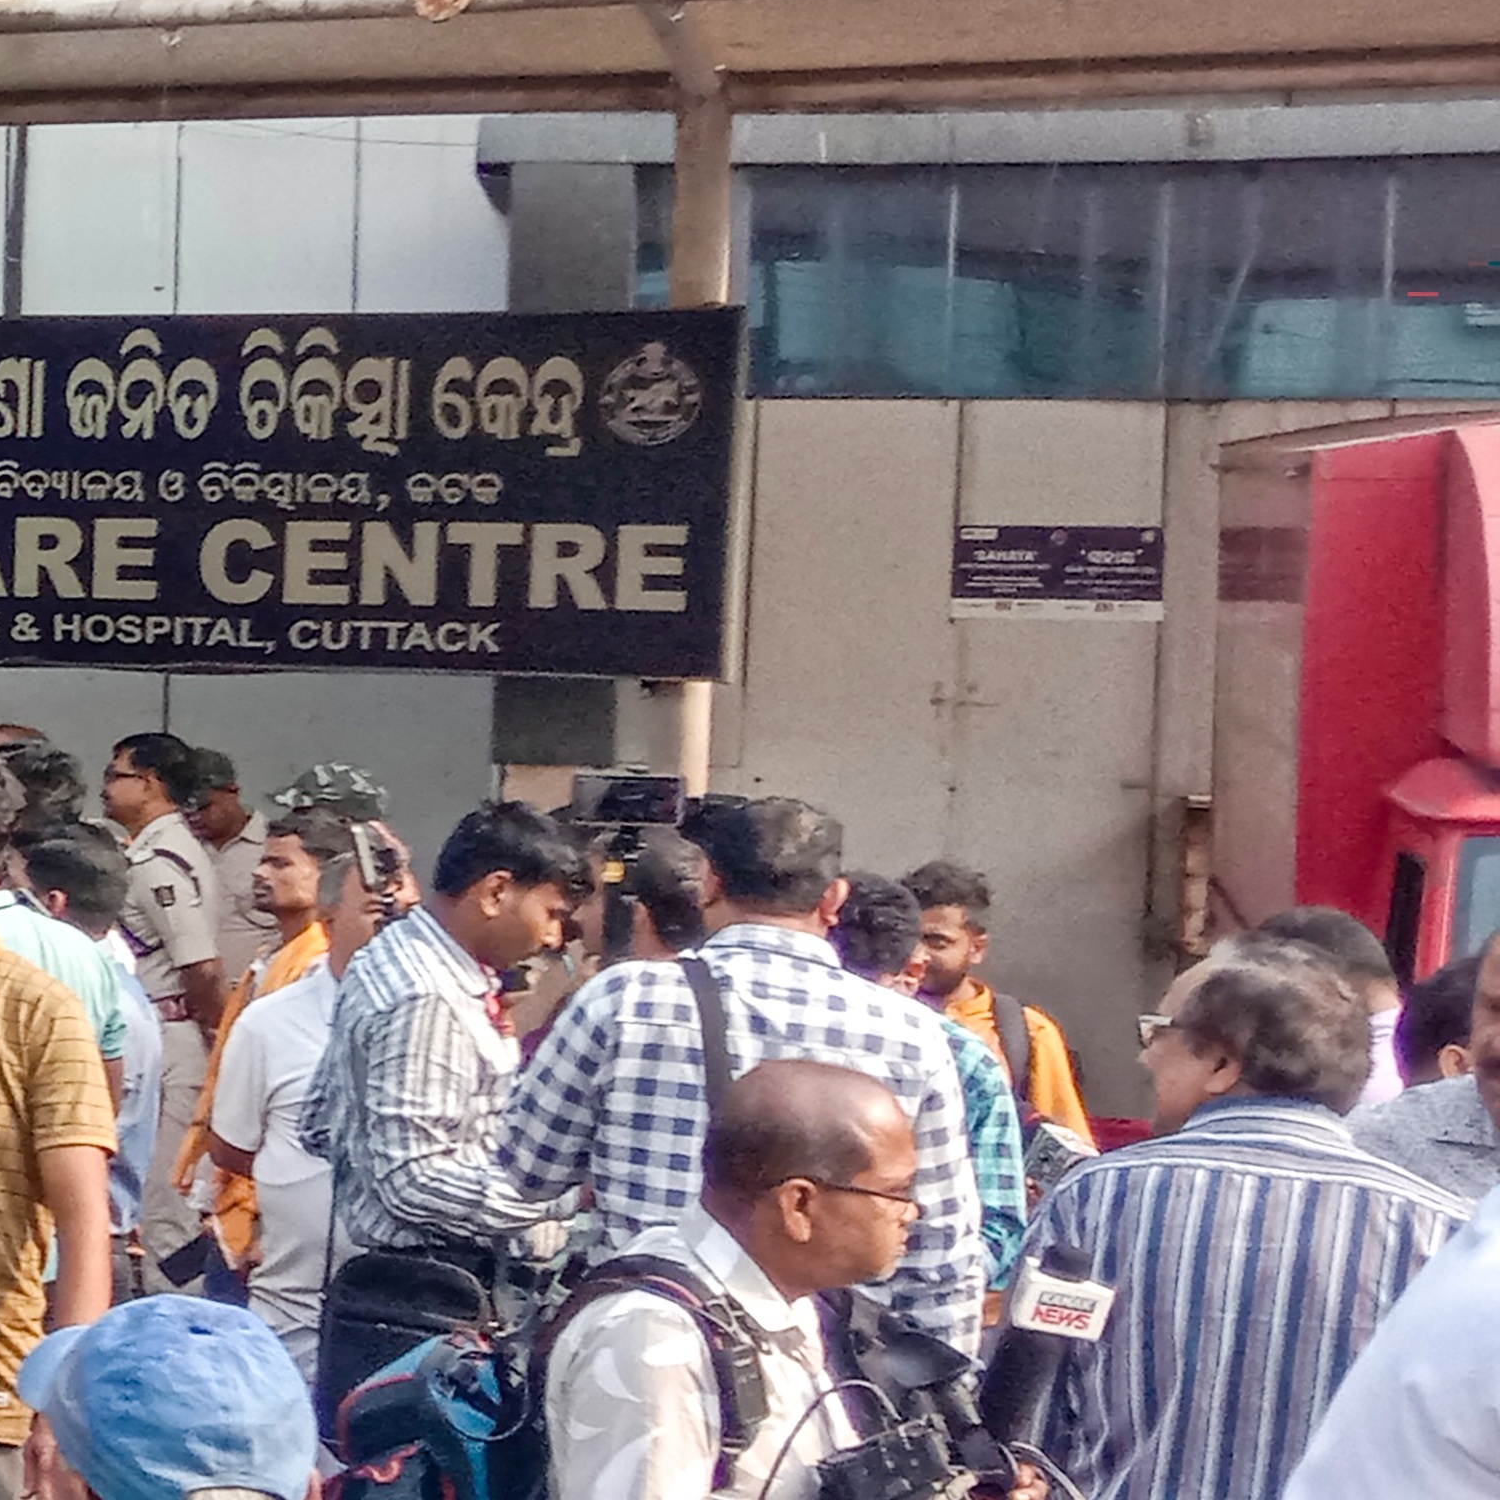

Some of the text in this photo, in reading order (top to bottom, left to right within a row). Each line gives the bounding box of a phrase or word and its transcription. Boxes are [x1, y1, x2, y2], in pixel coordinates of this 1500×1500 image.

[65, 327, 219, 440] ଜନିତ
[239, 326, 412, 457] ଚିକିତ୍ସା
[432, 355, 585, 458] କେନ୍ଦ୍ର
[158, 468, 188, 502] ଓ
[199, 516, 691, 614] CENTRE
[10, 614, 42, 643] &
[52, 613, 277, 655] HOSPITAL,
[287, 620, 500, 655] CUTTACK
[1030, 1305, 1092, 1330] NEWS
